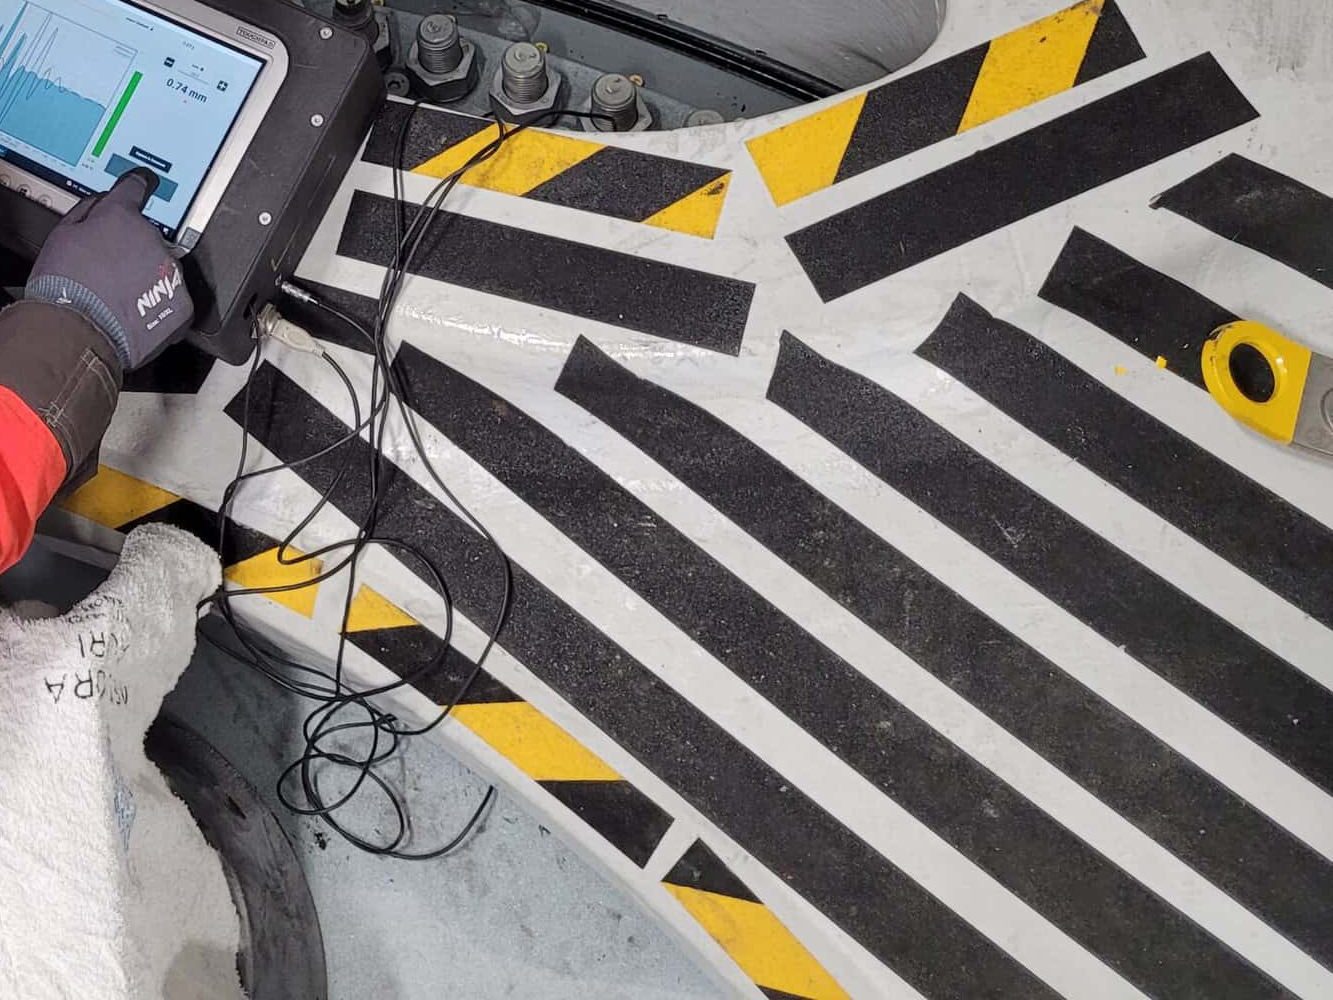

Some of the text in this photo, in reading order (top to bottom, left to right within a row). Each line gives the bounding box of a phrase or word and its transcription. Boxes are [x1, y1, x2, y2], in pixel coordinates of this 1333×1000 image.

[166, 78, 208, 103] 0.74 mm
[137, 265, 183, 318] NINJA
